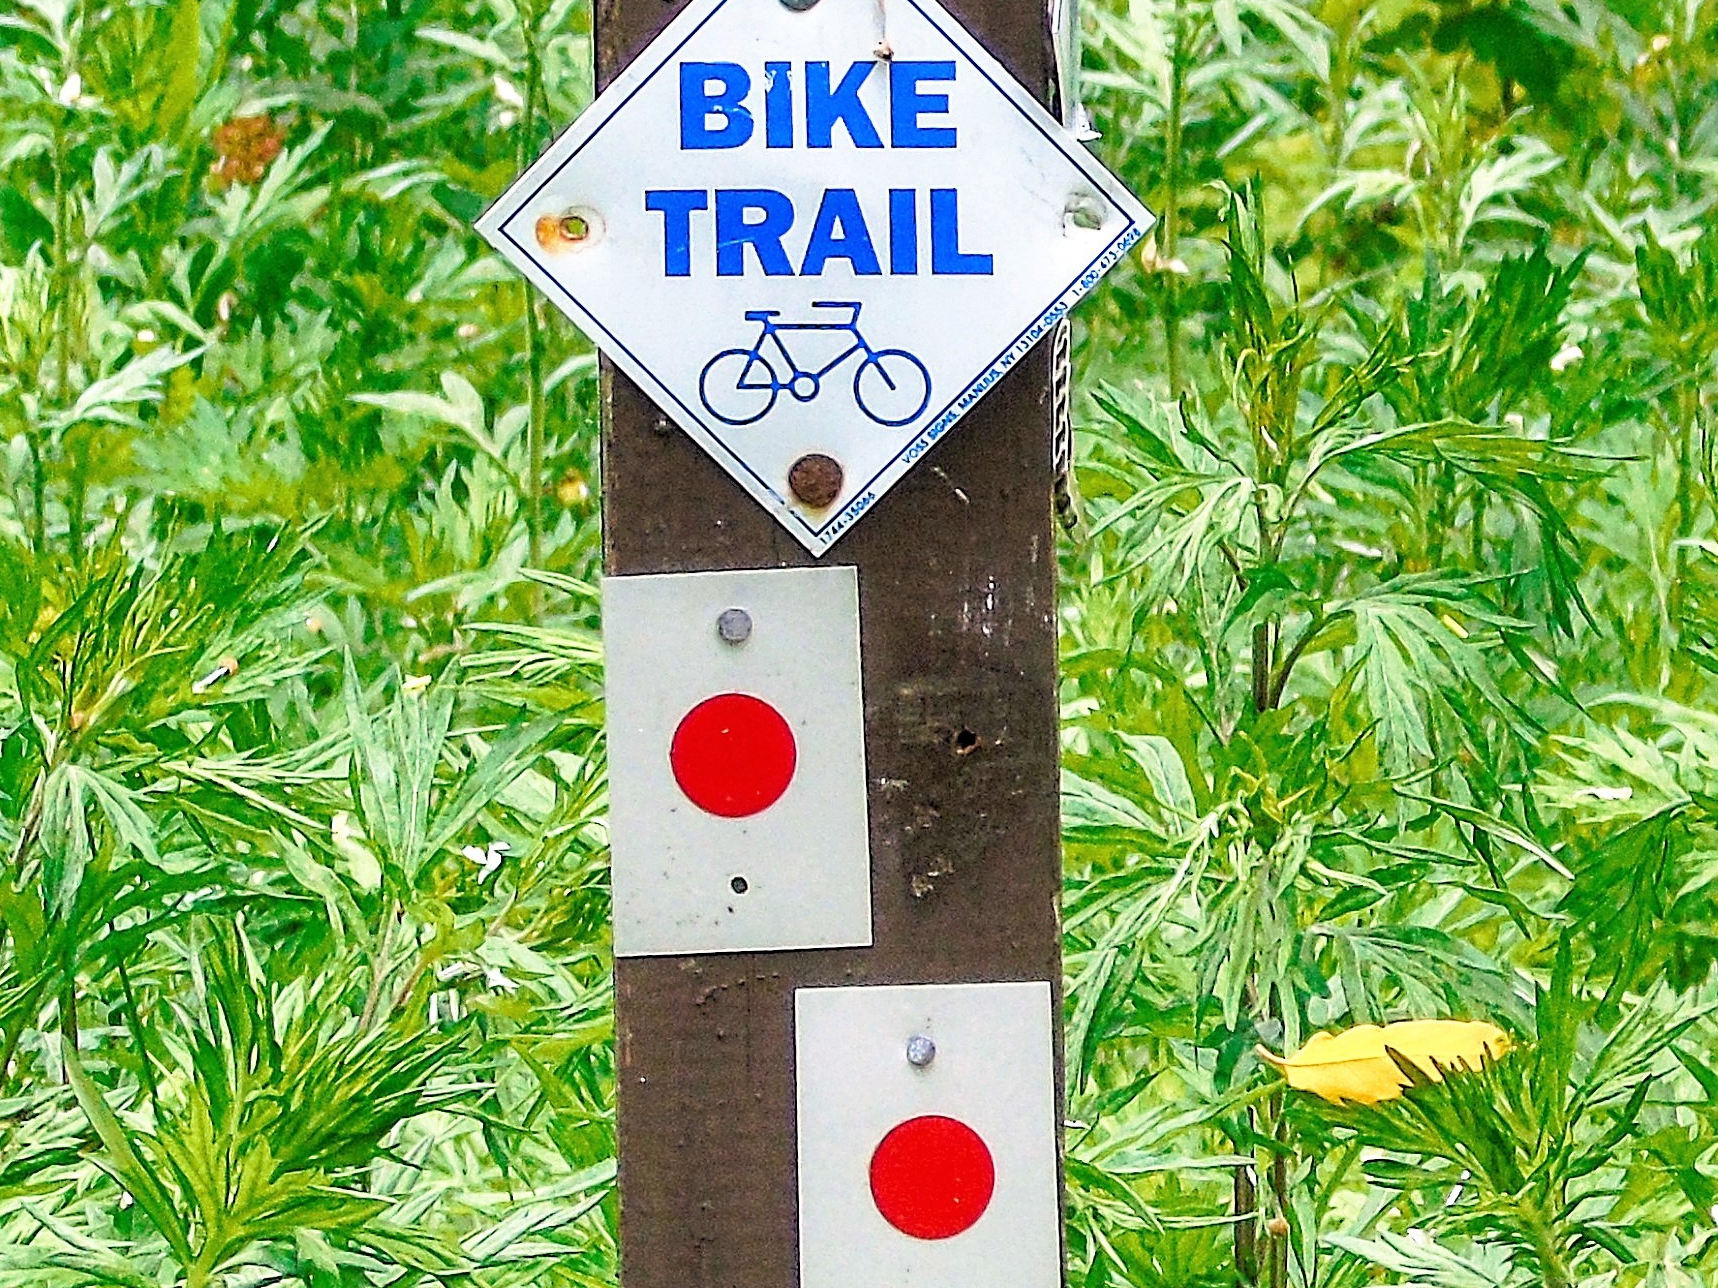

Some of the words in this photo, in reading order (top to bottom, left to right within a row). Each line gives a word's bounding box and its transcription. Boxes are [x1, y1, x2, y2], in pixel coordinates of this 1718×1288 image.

[679, 61, 958, 150] BIKE
[645, 188, 994, 277] TRAIL
[901, 437, 929, 465] VOSS
[999, 351, 1017, 368] NY
